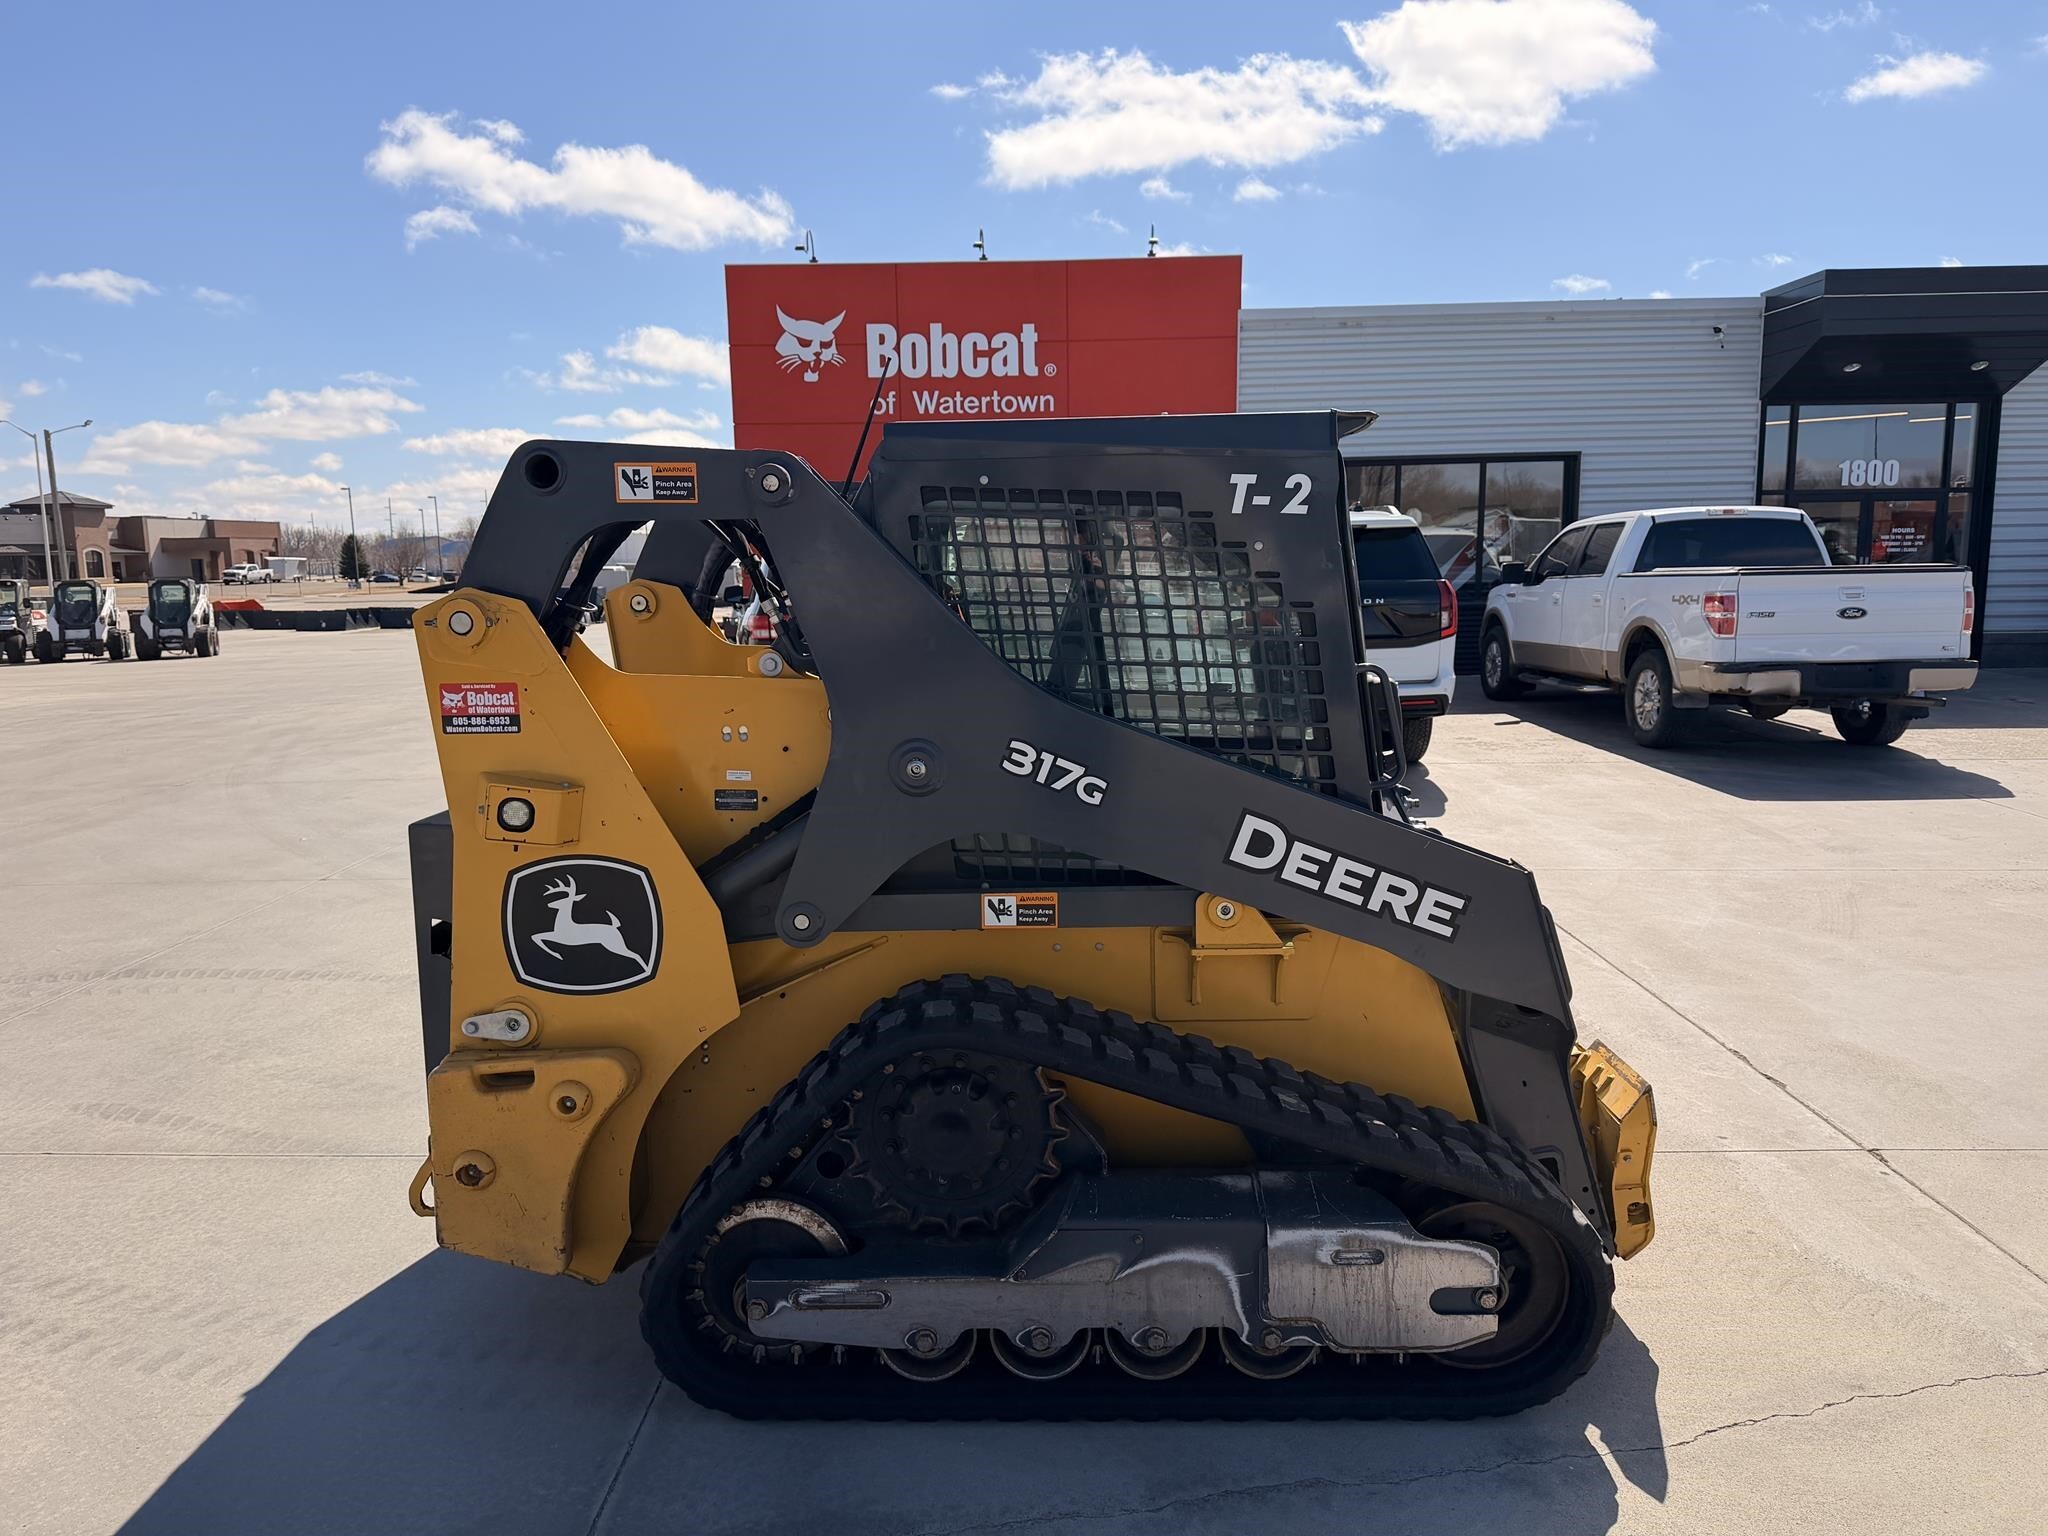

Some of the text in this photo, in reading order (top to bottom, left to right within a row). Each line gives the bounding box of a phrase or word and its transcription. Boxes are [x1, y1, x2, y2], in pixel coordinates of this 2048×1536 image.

[865, 322, 1039, 379] Bobcat
[869, 390, 1055, 415] of Watertown
[1838, 459, 1900, 487] 1800
[1844, 608, 1863, 617] Ford
[466, 691, 514, 706] Bobcat
[476, 706, 515, 714] Watertown
[452, 717, 510, 726] 605-886-6933
[1002, 740, 1108, 806] 317G
[1229, 813, 1466, 938] DEERE
